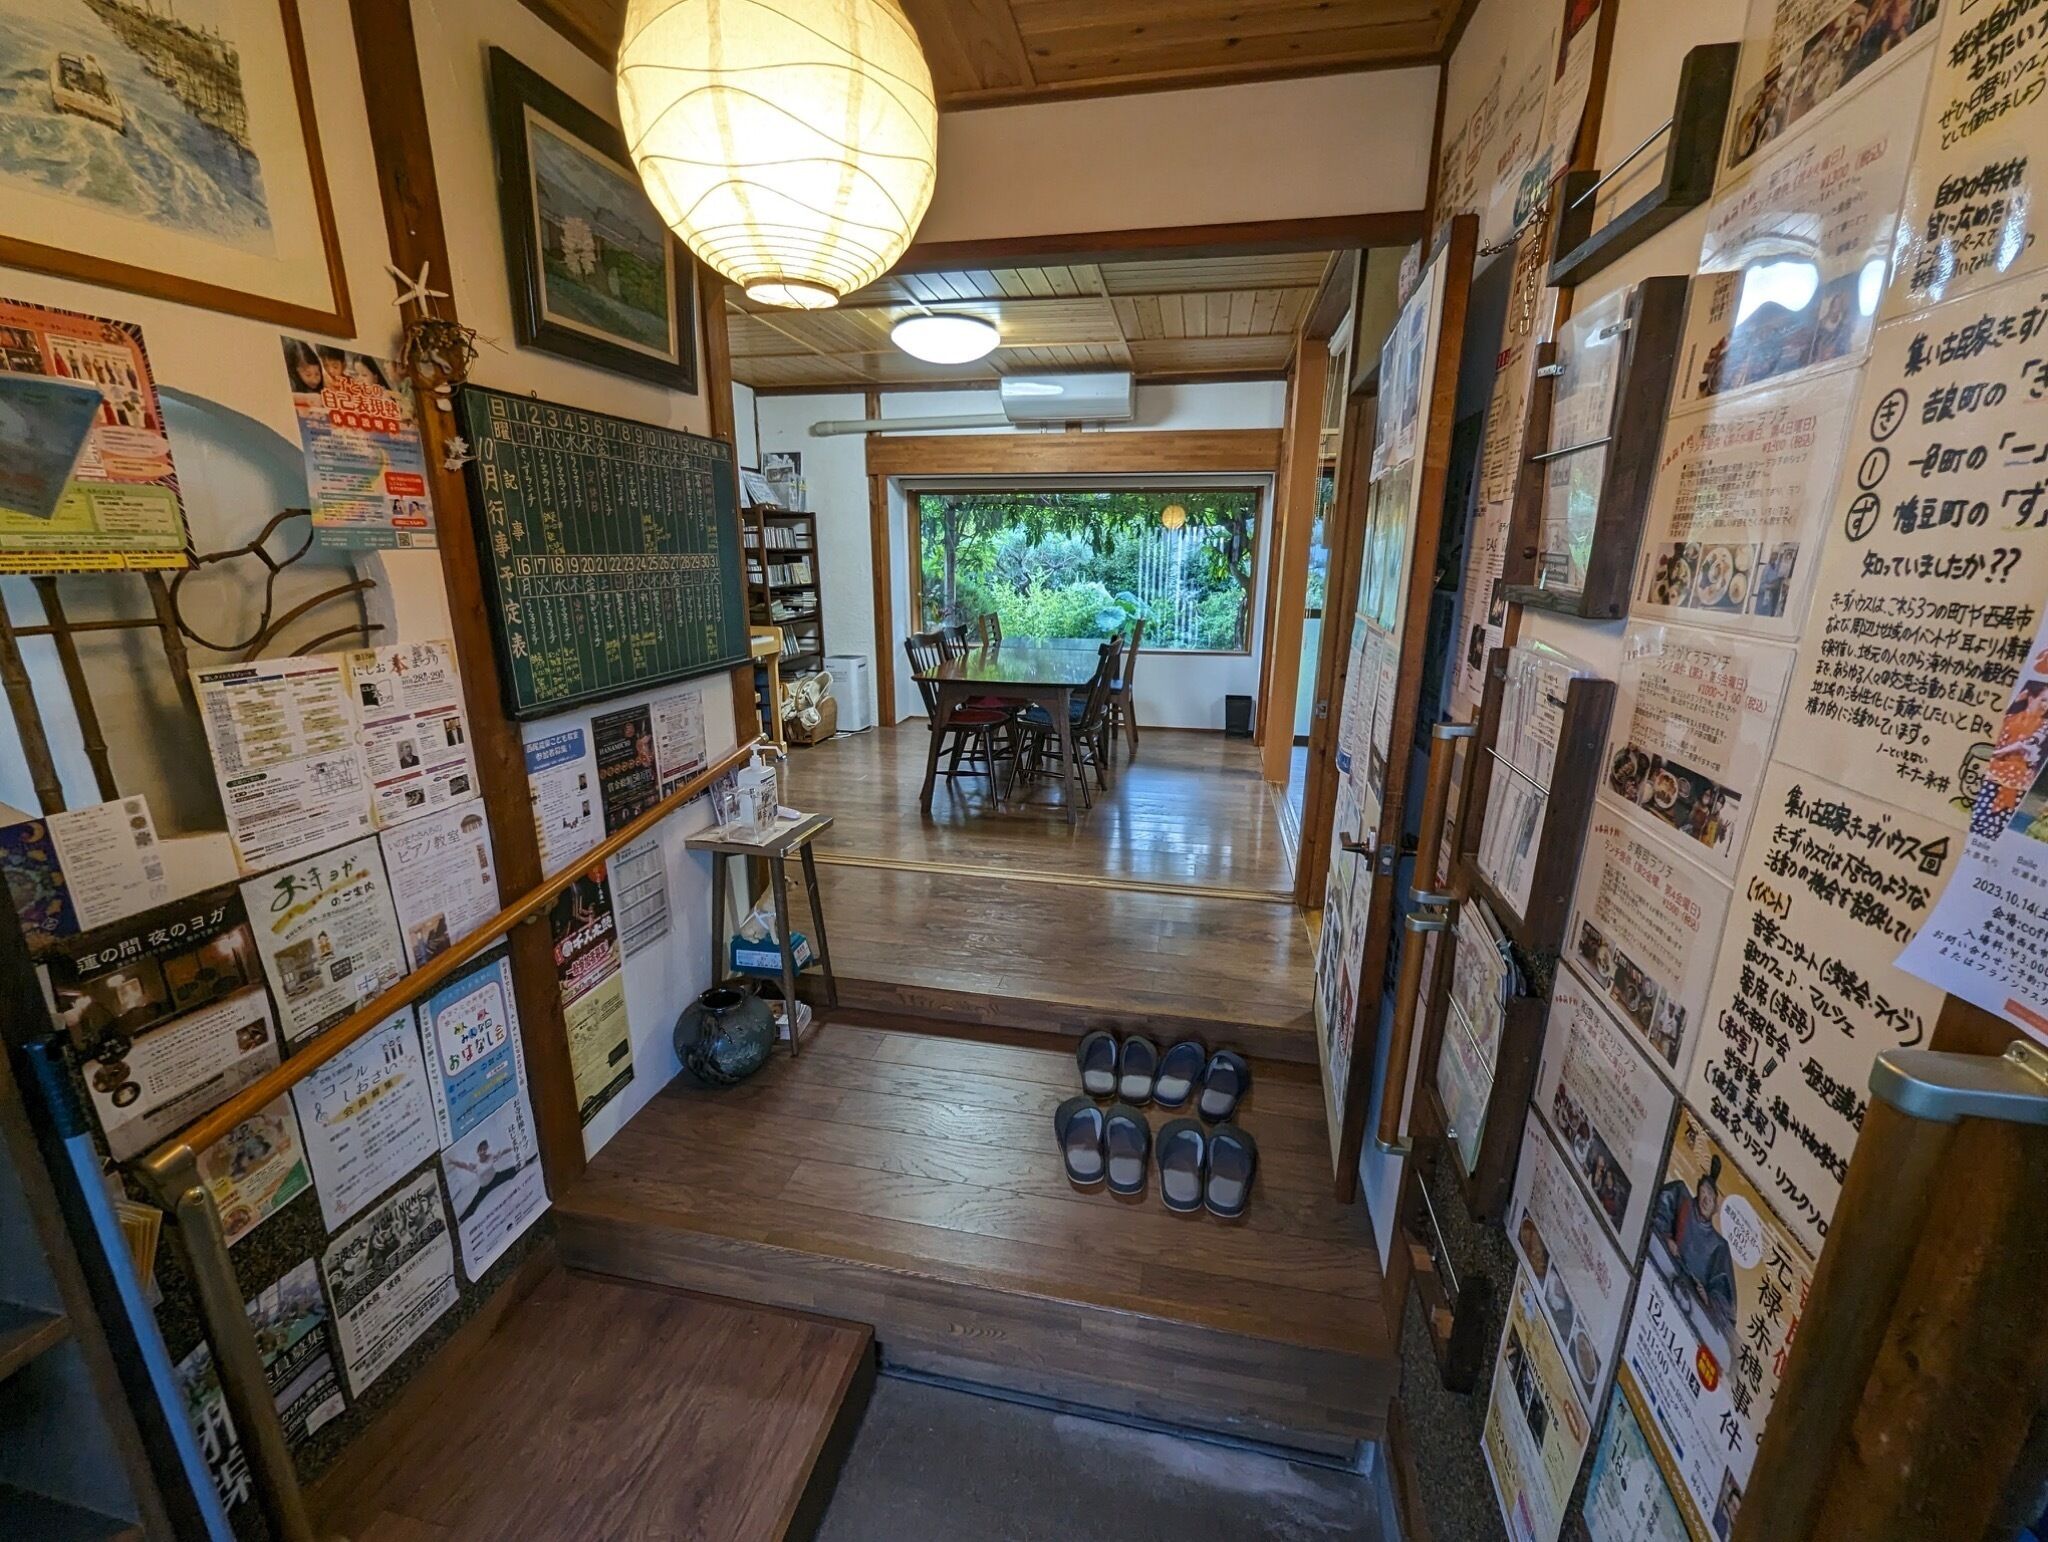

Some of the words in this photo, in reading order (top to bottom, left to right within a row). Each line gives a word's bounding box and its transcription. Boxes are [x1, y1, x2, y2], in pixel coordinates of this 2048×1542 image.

[322, 391, 402, 418] 自己表現塾
[491, 397, 507, 417] 日
[514, 401, 521, 421] 1
[529, 405, 542, 425] 2
[546, 410, 559, 428] 3
[562, 413, 575, 431] 4
[578, 416, 590, 433] 5
[593, 419, 603, 436] 6
[608, 422, 616, 439] 7
[621, 425, 631, 441] 8
[635, 428, 645, 443] 9
[645, 431, 656, 446] 10
[493, 420, 512, 441] 曜
[533, 426, 544, 446] 月
[550, 431, 563, 449] 火
[565, 434, 580, 451] 水
[581, 436, 595, 455] 木
[516, 557, 531, 575] 16
[534, 558, 546, 574] 17
[550, 557, 565, 574] 18
[567, 557, 579, 573] 19
[581, 557, 594, 572] 20
[597, 557, 608, 572] 21
[610, 557, 622, 572] 22
[623, 557, 635, 571] 23
[636, 557, 647, 571] 24
[649, 557, 659, 570] 25
[660, 557, 670, 570] 26
[671, 557, 680, 570] 27
[681, 557, 690, 570] 28
[691, 557, 700, 569] 29
[701, 557, 710, 569] 30
[710, 557, 719, 568] 31
[522, 579, 532, 597] 月
[538, 578, 550, 595] 火
[555, 577, 568, 594] 水
[570, 576, 583, 592] 木
[585, 576, 597, 592] 金
[397, 829, 462, 864] ピアノ教室
[331, 880, 376, 908] のご案内
[77, 936, 142, 975] 蓮の間
[148, 905, 226, 944] 夜のヨガ
[449, 1023, 504, 1071] おはなし会
